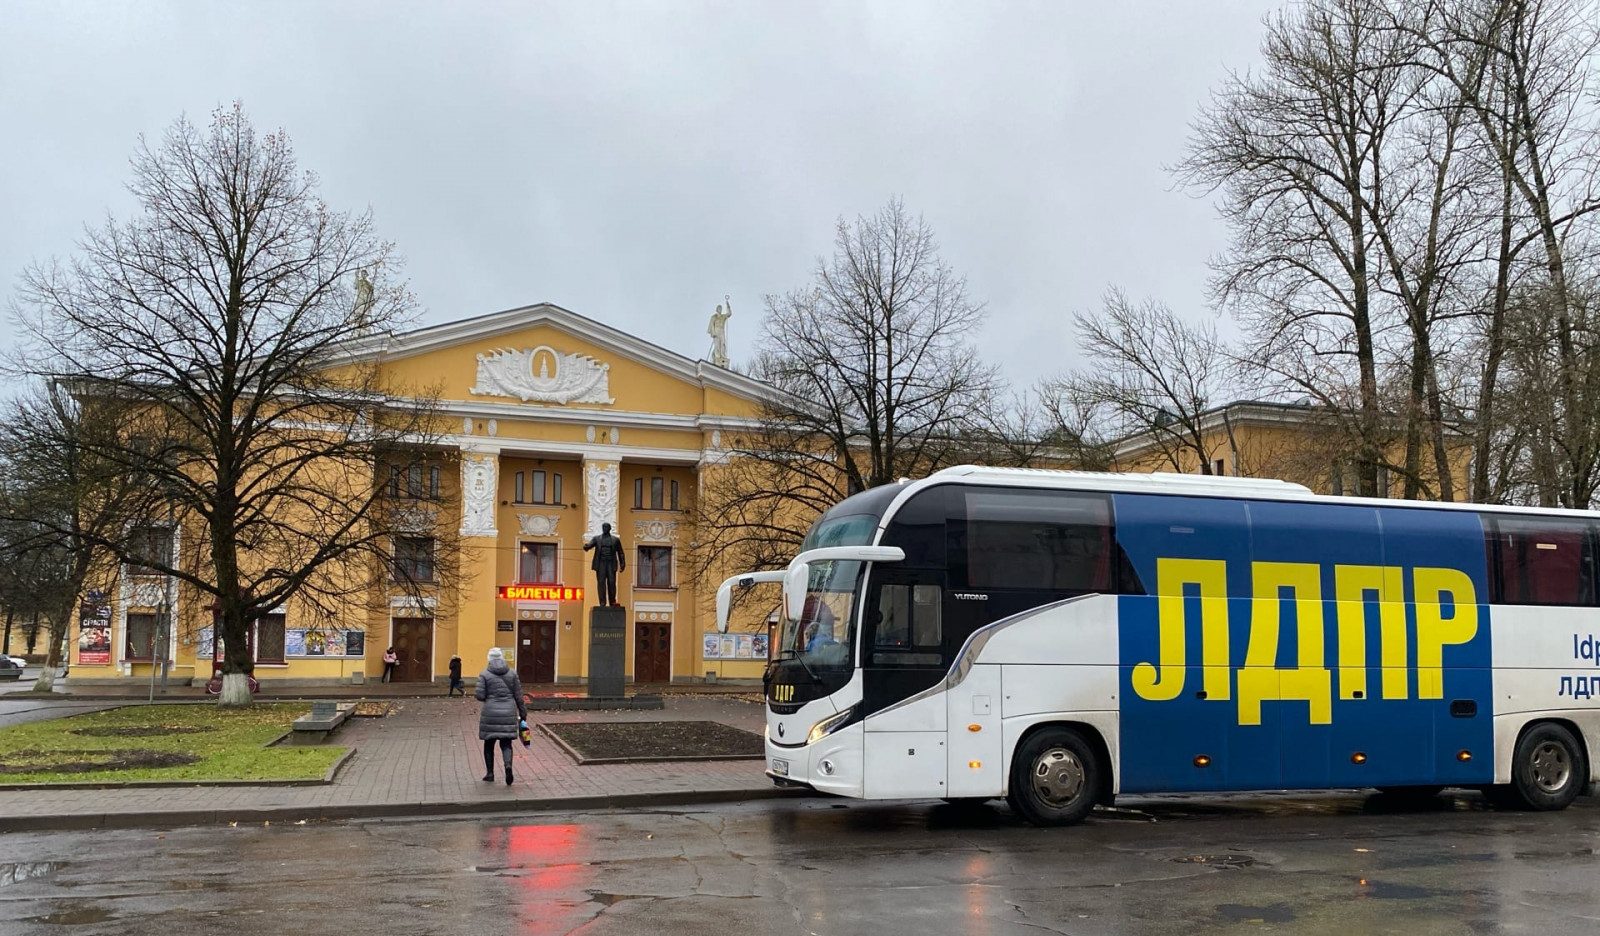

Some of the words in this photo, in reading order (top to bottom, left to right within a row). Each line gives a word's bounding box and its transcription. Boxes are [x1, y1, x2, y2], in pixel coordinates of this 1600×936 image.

[507, 587, 561, 600] БИЛЕТЫ
[564, 587, 573, 600] В
[954, 593, 989, 601] YUTONG
[1132, 558, 1479, 725] ЛДПР
[775, 684, 795, 702] ЛДПР
